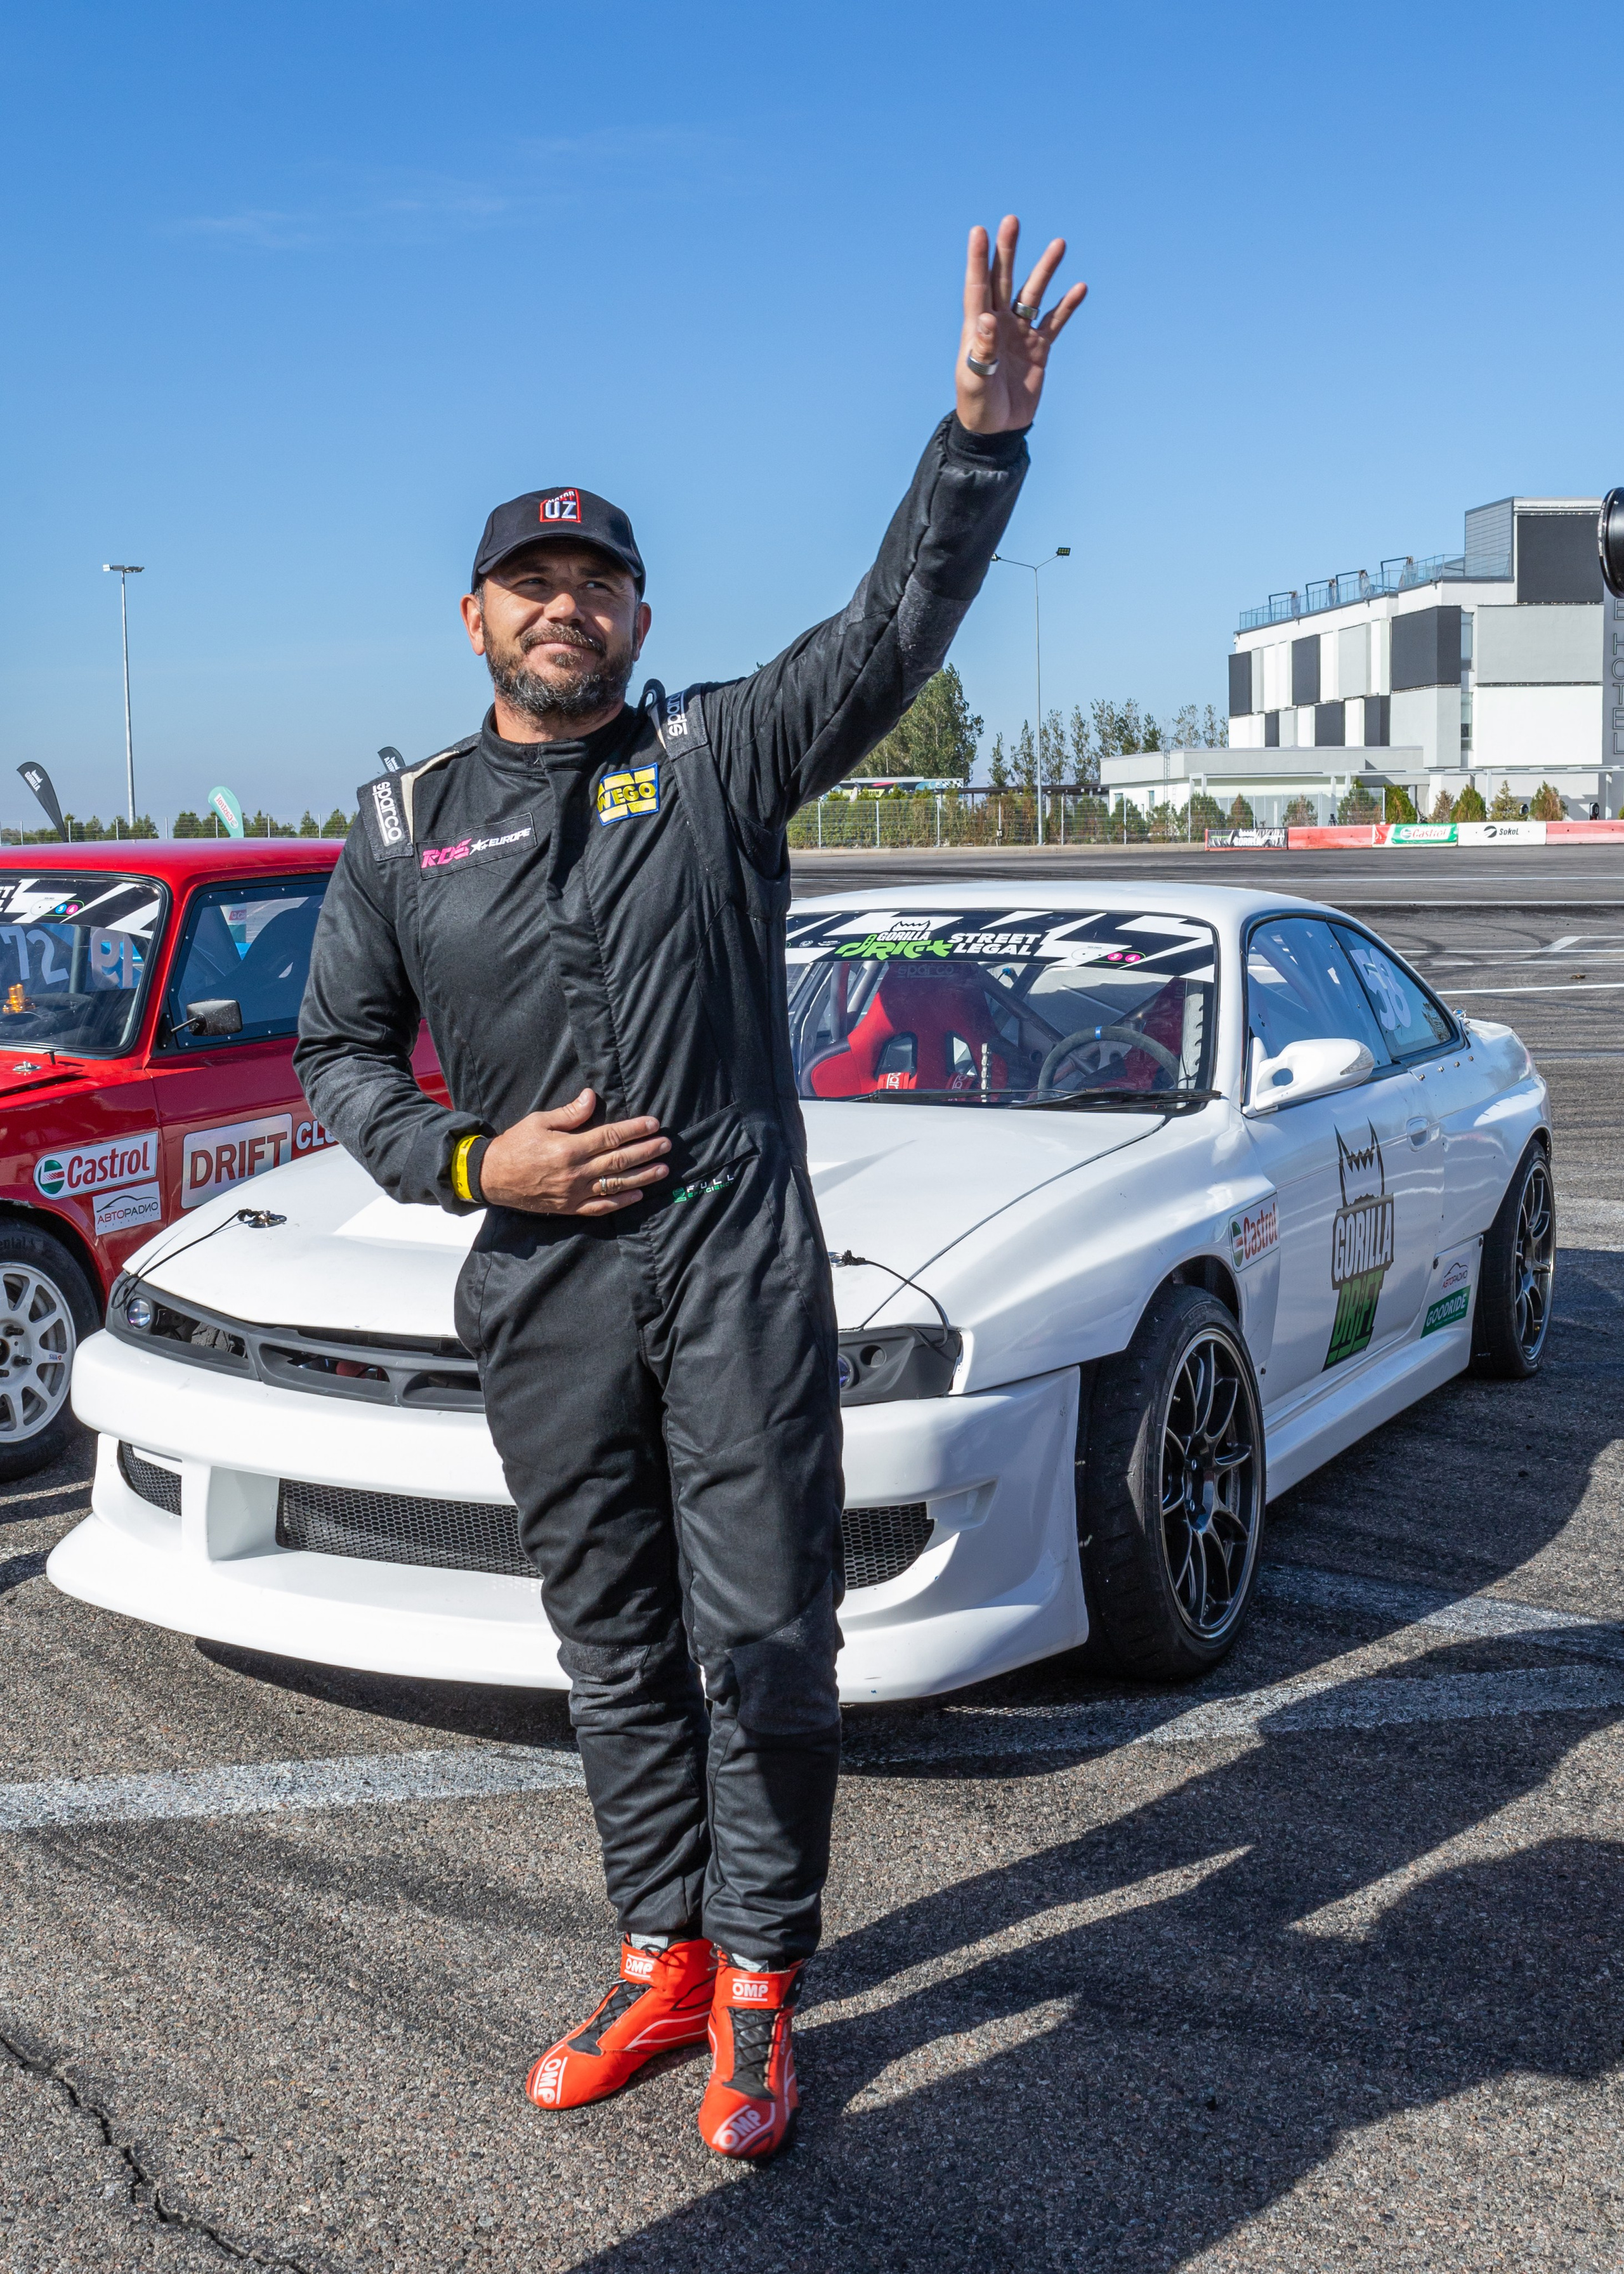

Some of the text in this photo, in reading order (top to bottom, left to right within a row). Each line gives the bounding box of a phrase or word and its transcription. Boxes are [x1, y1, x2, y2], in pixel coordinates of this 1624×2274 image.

[545, 500, 577, 519] UZ
[667, 693, 687, 736] sparc
[25, 771, 41, 792] GORILLA
[597, 782, 656, 813] WEGO
[372, 781, 402, 842] sparco
[421, 827, 531, 868] RDS EUROPE
[1412, 829, 1447, 839] Castrol
[0, 925, 69, 984] 72
[877, 931, 931, 941] GORILLA
[947, 932, 1042, 944] STREET
[953, 943, 1031, 956] LEGAL
[1349, 948, 1411, 1031] 58
[67, 1140, 150, 1189] Castrol
[190, 1131, 288, 1190] DRIFT
[686, 1174, 734, 1193] FULL
[1243, 1201, 1278, 1260] Castrol
[1333, 1201, 1392, 1283] GORILLA
[1330, 1269, 1384, 1356] DRIFT
[1425, 1293, 1467, 1328] GOODRIDE
[625, 1957, 653, 1975] OMP
[732, 1982, 769, 1998] OMP
[538, 2058, 562, 2104] OMP
[718, 2110, 761, 2150] OMP
